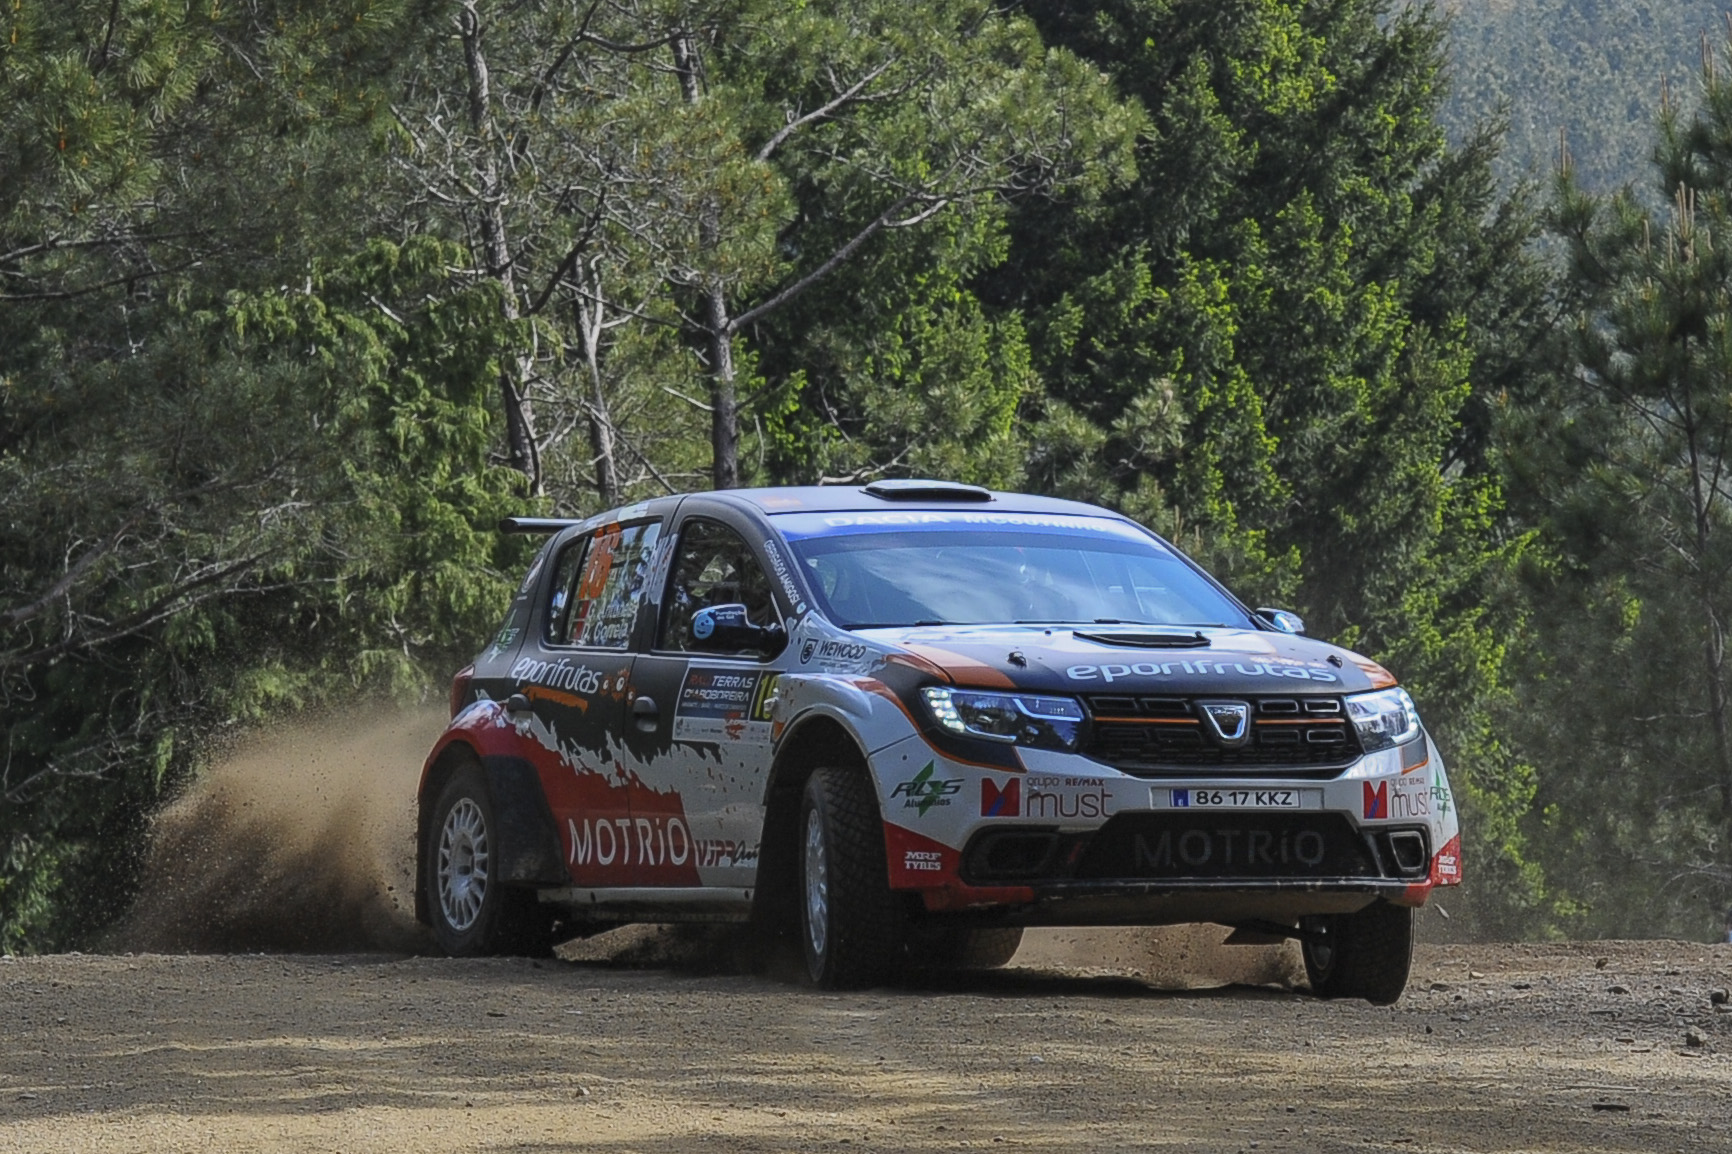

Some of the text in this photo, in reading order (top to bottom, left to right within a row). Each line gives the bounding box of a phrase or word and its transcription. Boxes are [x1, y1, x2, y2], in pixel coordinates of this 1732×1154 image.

[823, 513, 950, 527] DACIA
[818, 640, 867, 660] WEWOOD
[511, 656, 602, 695] eporifrutas
[1066, 659, 1337, 683] eporifrutas
[711, 675, 755, 689] TERRAS
[1065, 777, 1105, 787] RE/MAX
[1026, 788, 1114, 818] must
[1255, 791, 1293, 806] KKZ
[904, 851, 942, 860] MRF
[904, 861, 942, 871] TYRES
